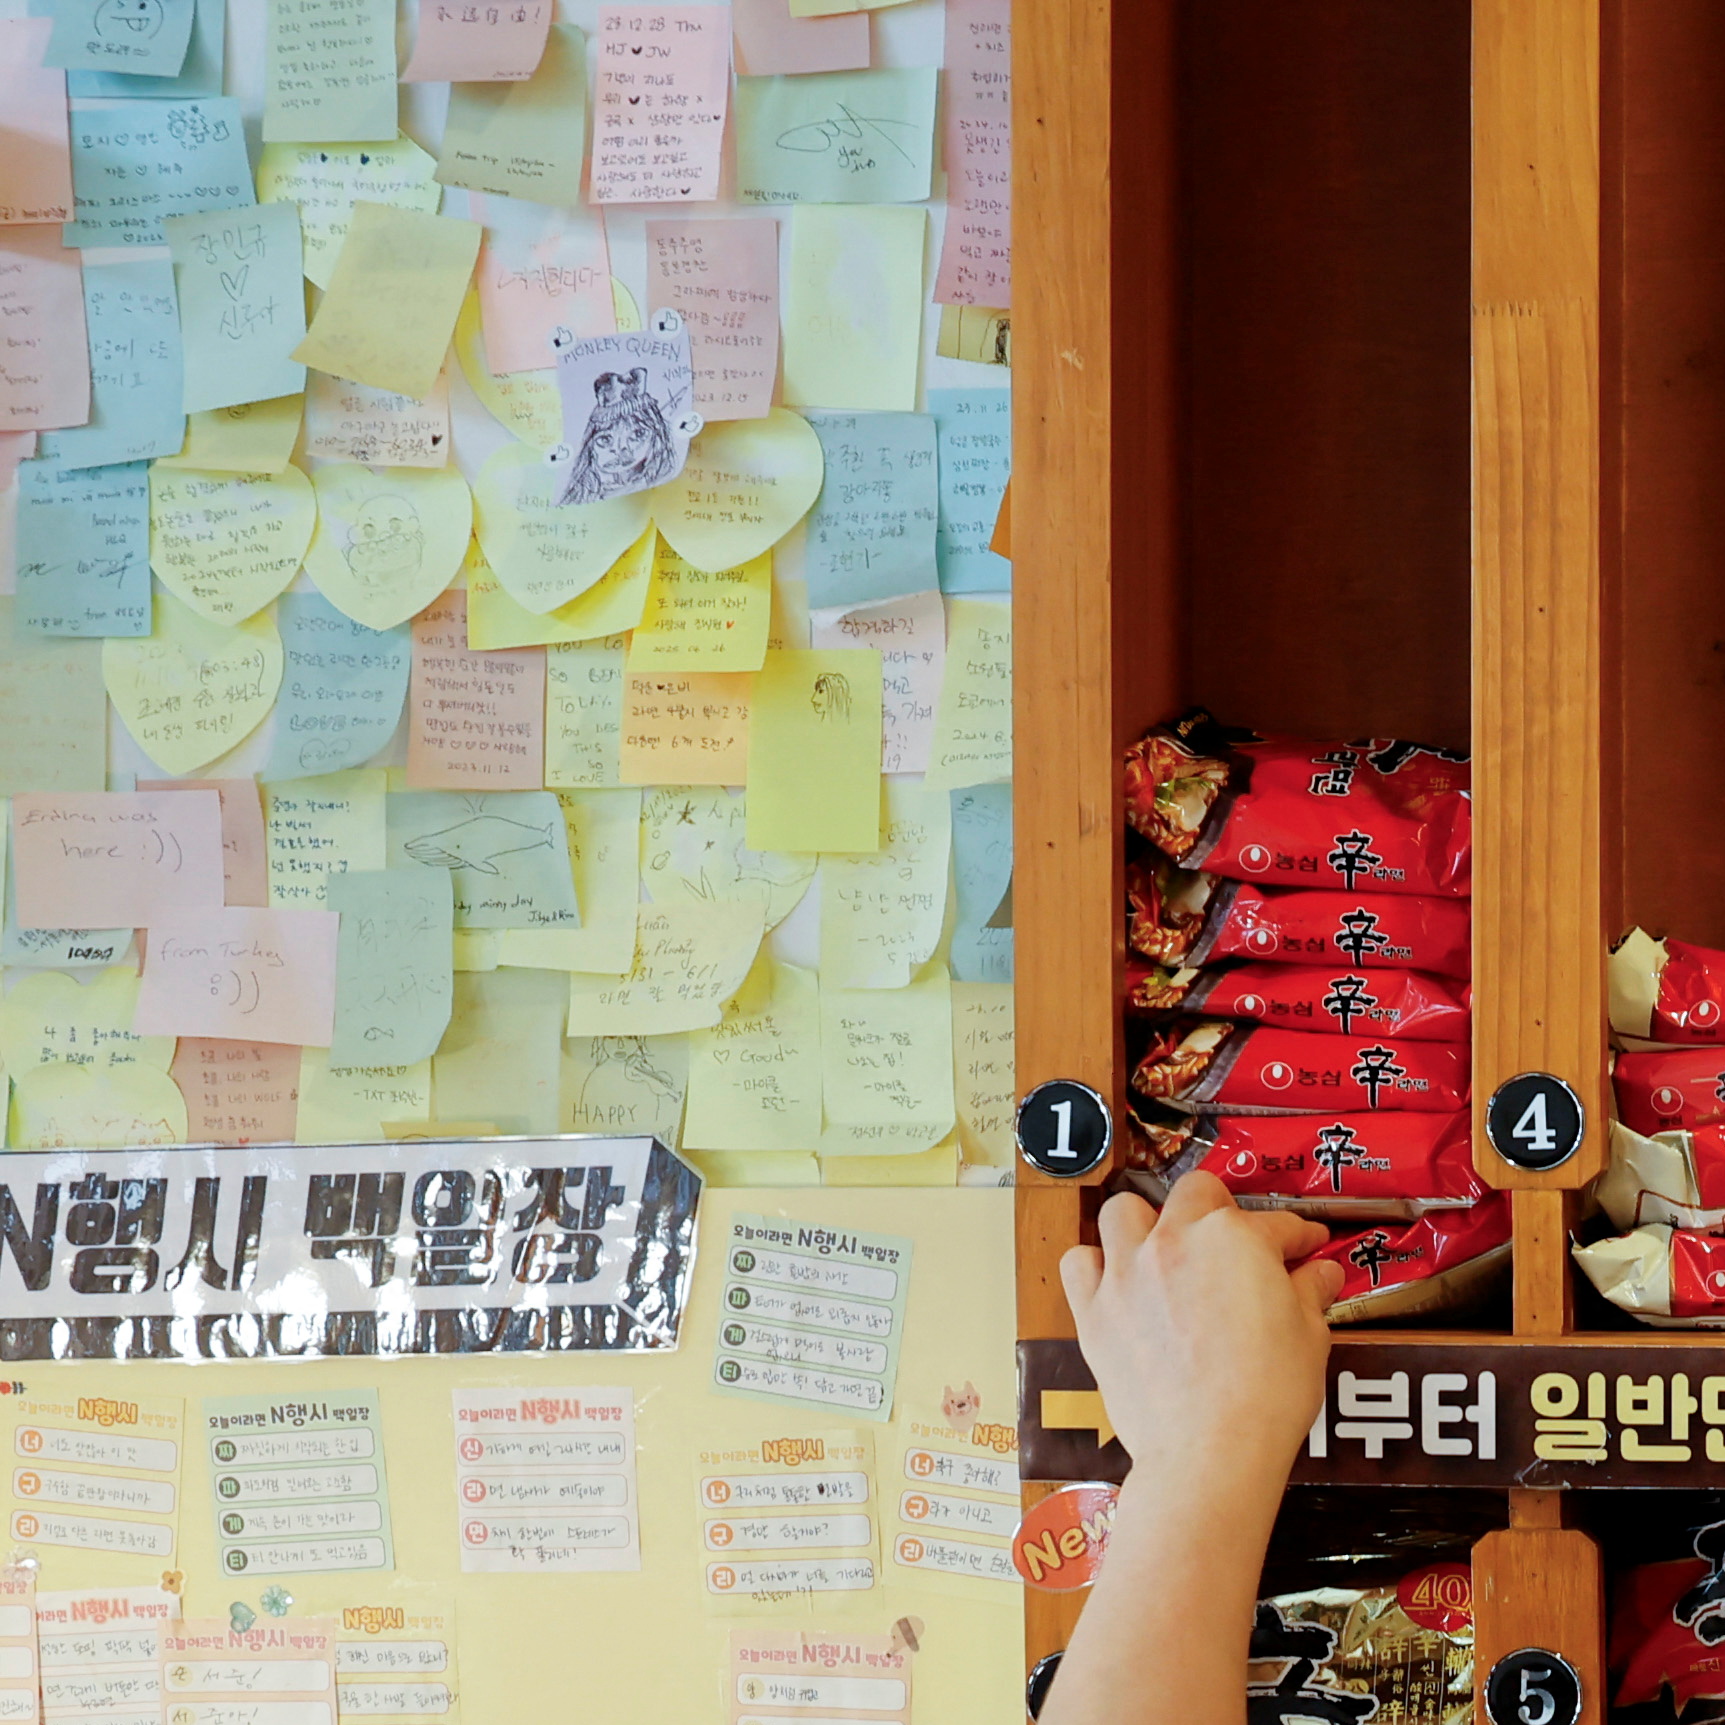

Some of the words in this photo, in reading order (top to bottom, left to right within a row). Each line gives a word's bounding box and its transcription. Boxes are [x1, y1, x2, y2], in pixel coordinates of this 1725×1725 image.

[563, 339, 621, 364] MONKEY
[625, 337, 682, 363] QUEEN
[1273, 850, 1319, 873] 농심
[1280, 933, 1326, 955] 농심
[1297, 1066, 1342, 1088] 농심
[1047, 1102, 1078, 1159] 1
[1512, 1092, 1557, 1152] 4
[303, 1165, 626, 1290] 백일장
[733, 1224, 793, 1246] 오늘이라면
[798, 1228, 857, 1255] N행시
[861, 1245, 899, 1264] 백일장
[209, 1413, 266, 1430] 오늘이라면
[270, 1403, 329, 1427] N행시
[332, 1407, 370, 1422] 백일장
[1306, 1370, 1497, 1462] 부터
